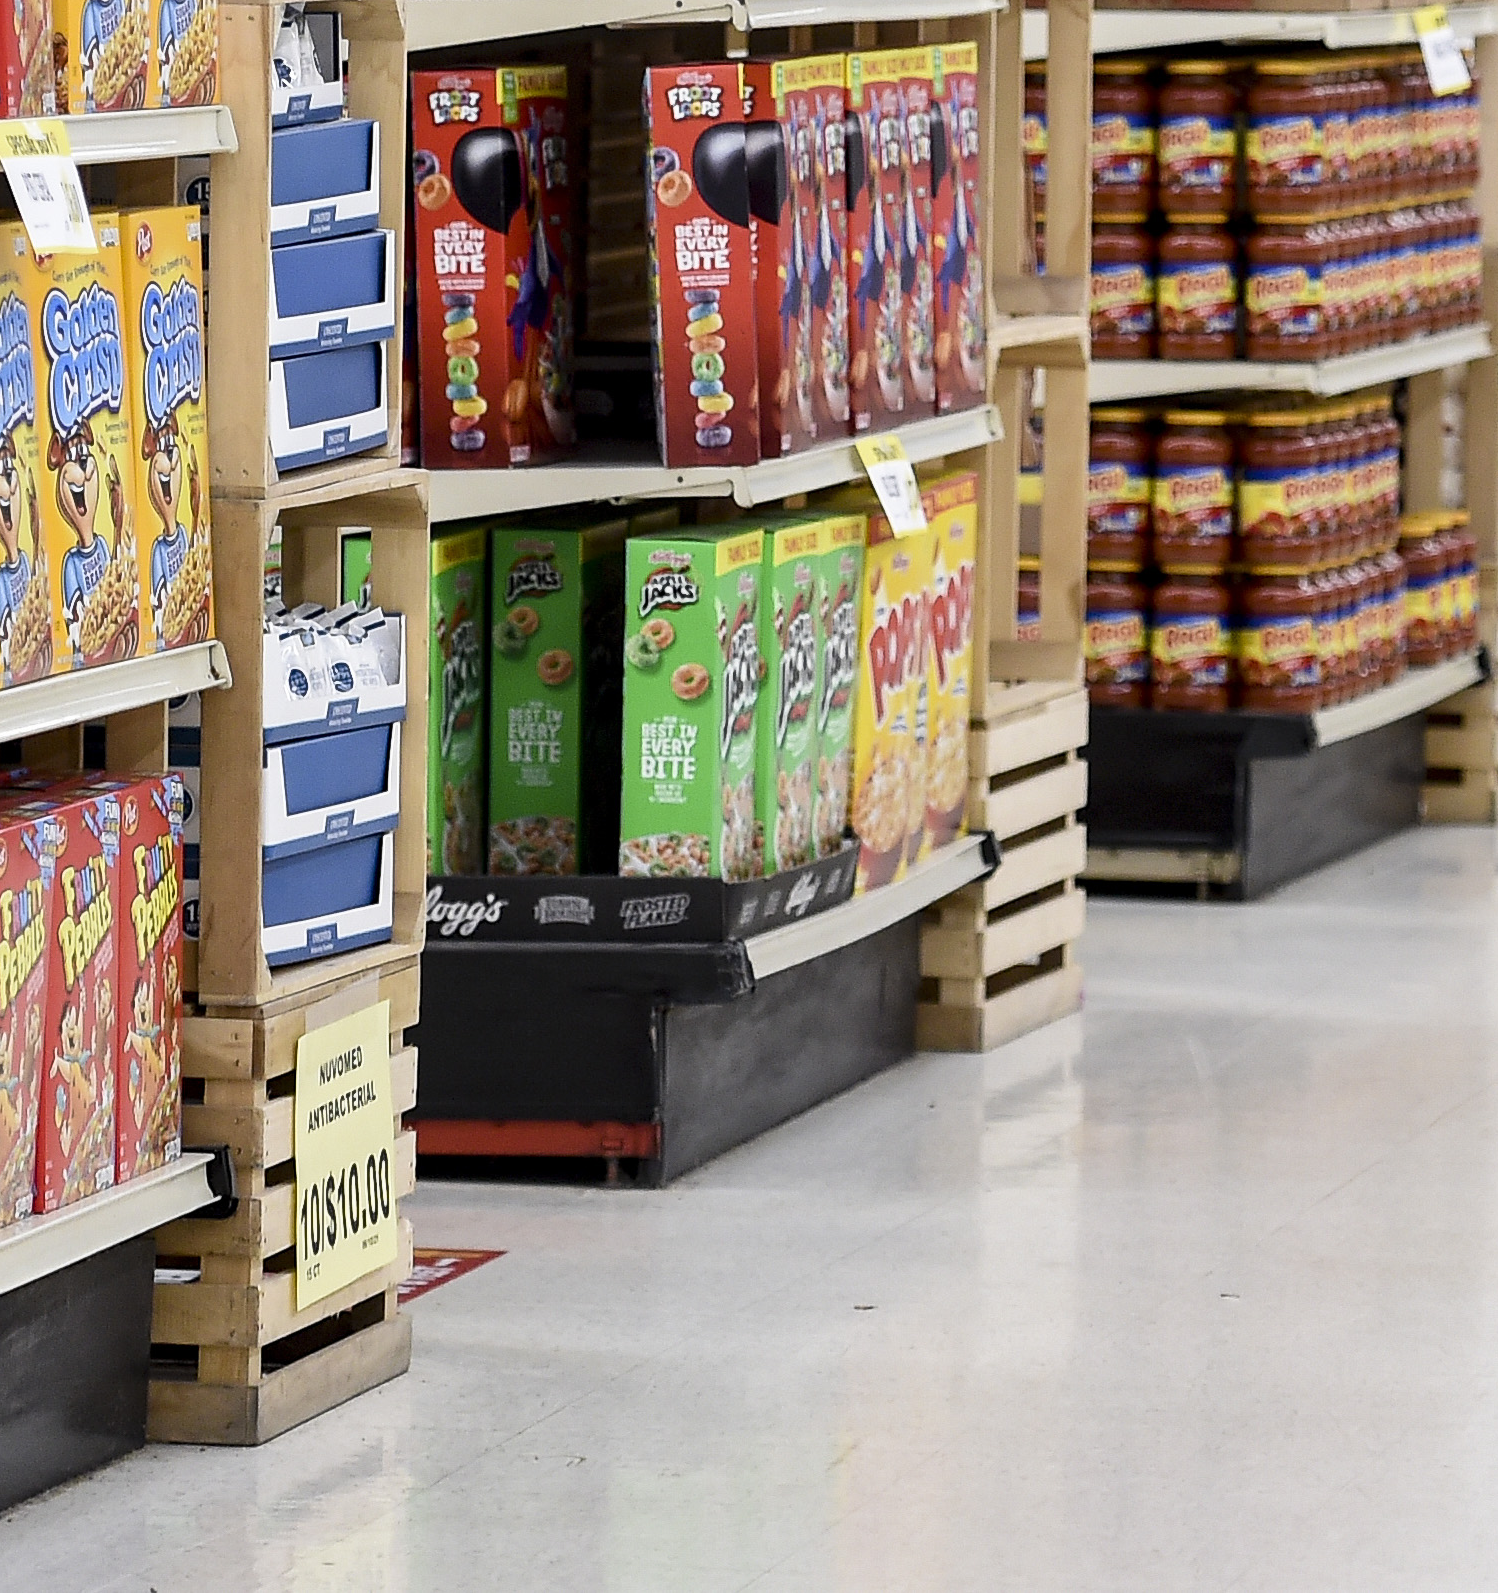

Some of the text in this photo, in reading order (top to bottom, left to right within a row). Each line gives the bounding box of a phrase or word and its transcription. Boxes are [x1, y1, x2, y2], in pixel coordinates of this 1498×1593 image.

[429, 91, 481, 107] FROOT
[667, 87, 722, 105] FROOT
[433, 107, 480, 124] LOOPS
[672, 103, 721, 120] LOOPS
[675, 224, 711, 238] BEST
[675, 237, 728, 252] EVERY
[434, 255, 485, 274] BITE
[676, 252, 731, 271] BITE
[640, 583, 699, 617] JACKS
[641, 723, 697, 738] BEST IN
[641, 738, 697, 757] EVERY
[641, 757, 697, 780] BITE
[319, 1045, 363, 1087] NUVOMED
[307, 1080, 377, 1134] ANTIBACTERIAL
[300, 1148, 392, 1261] 10/$10.00
